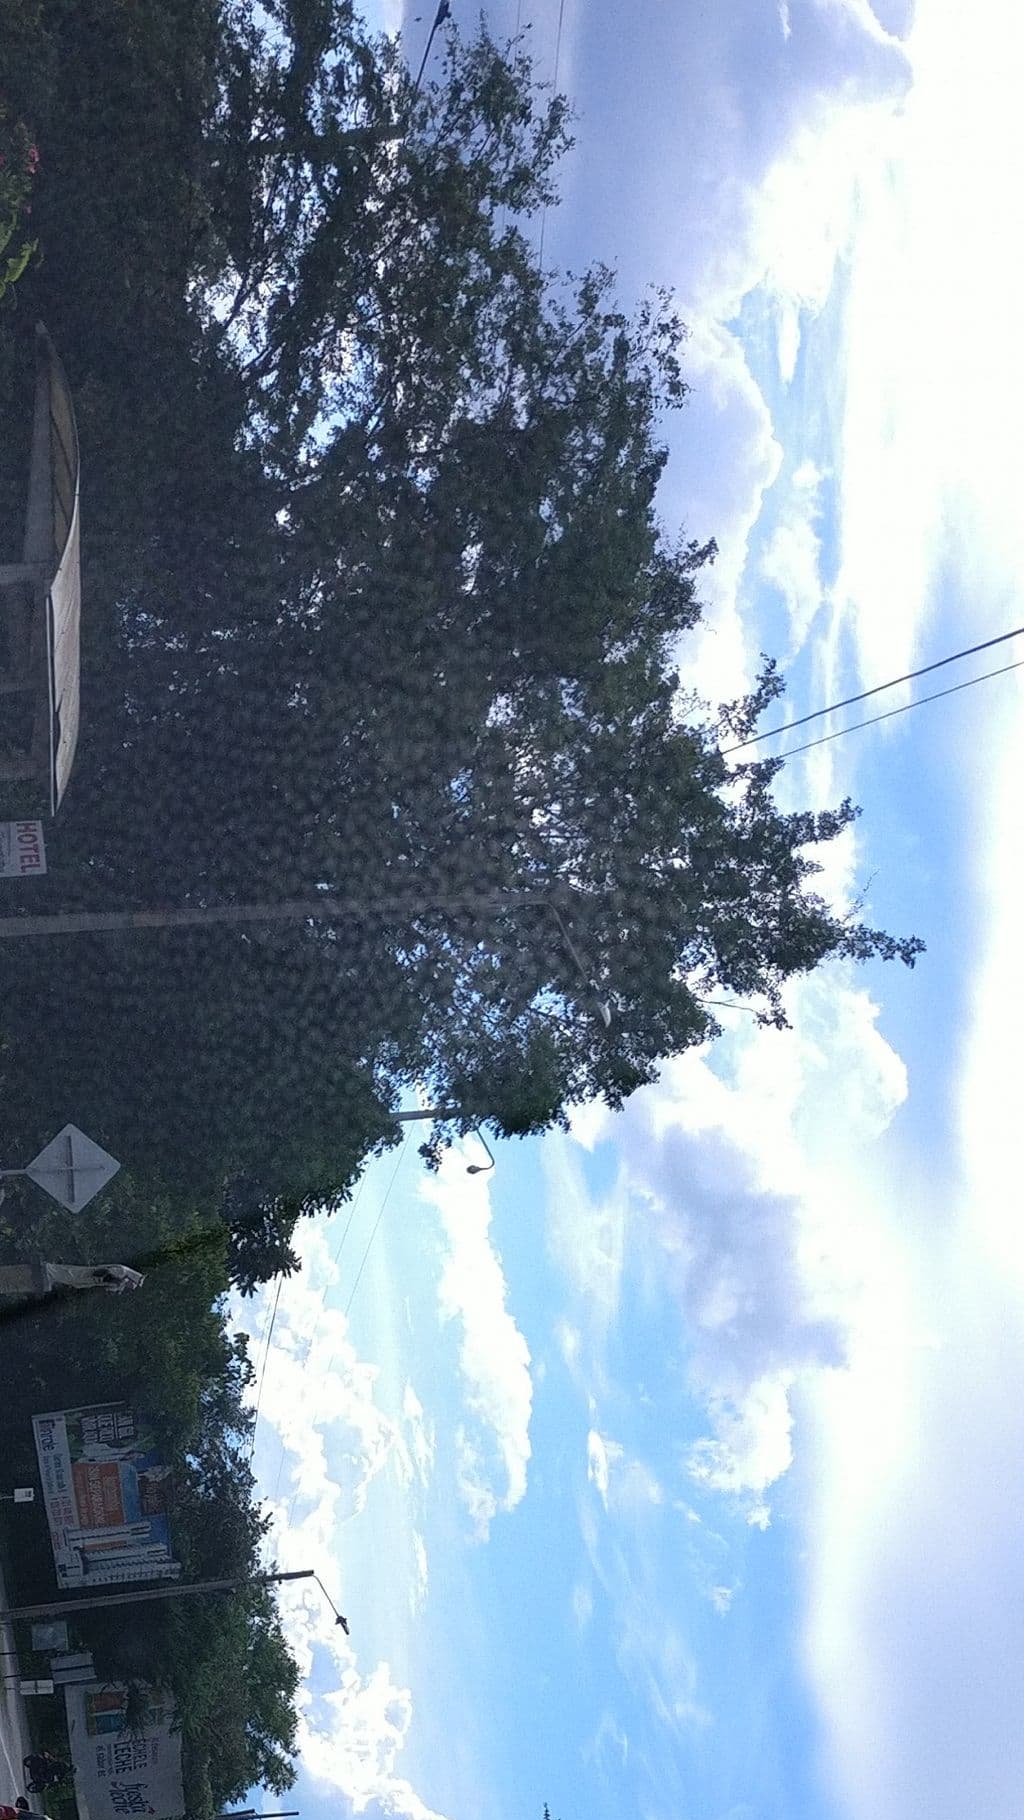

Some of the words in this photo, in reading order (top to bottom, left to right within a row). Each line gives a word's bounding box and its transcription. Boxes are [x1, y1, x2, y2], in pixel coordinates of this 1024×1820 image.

[16, 823, 41, 873] HOTEL
[113, 1742, 133, 1774] LECHE
[108, 1789, 131, 1815] leche
